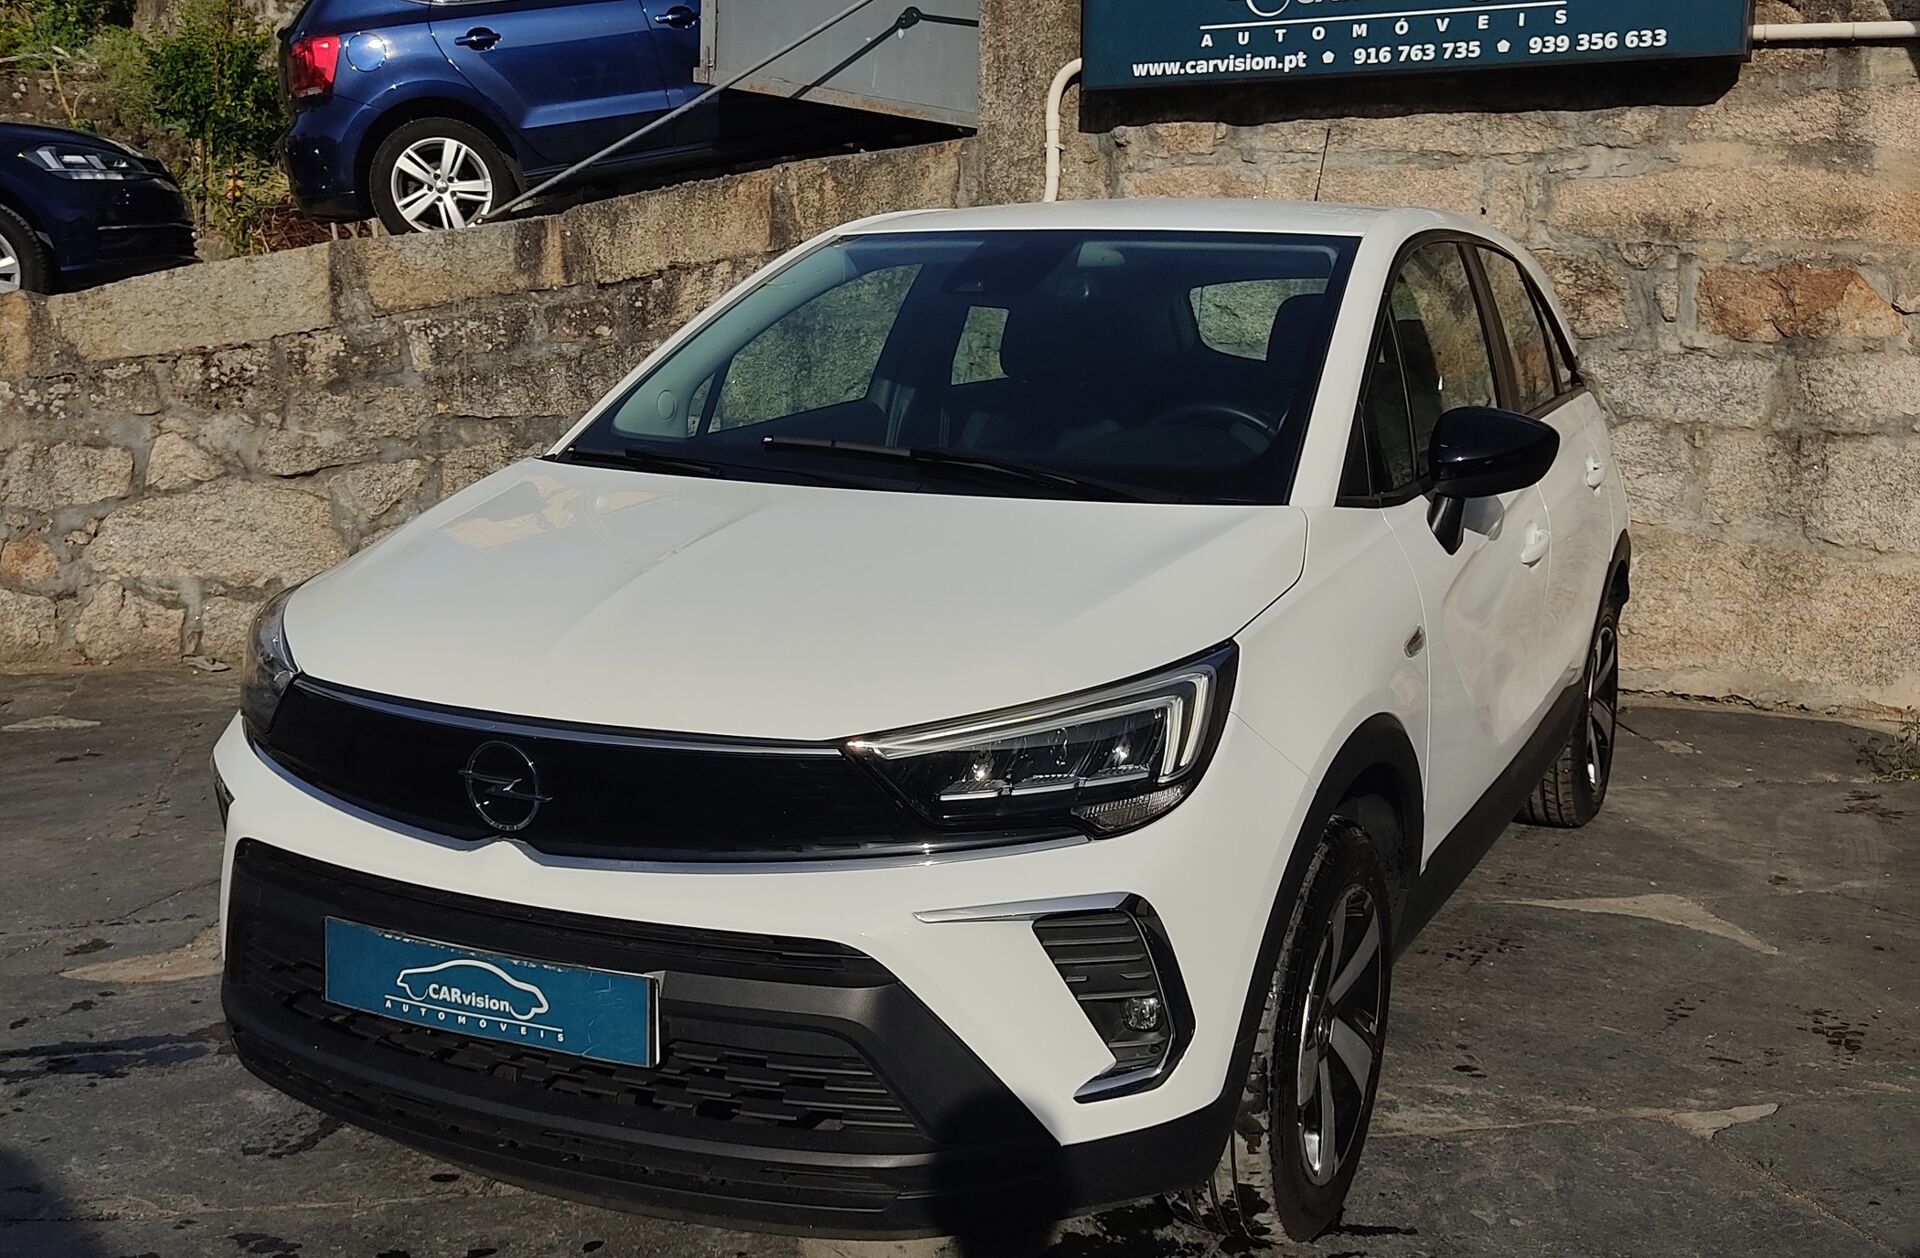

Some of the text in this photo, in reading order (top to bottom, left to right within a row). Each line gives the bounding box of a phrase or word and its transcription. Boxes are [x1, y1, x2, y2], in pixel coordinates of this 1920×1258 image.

[1200, 10, 1568, 48] AUTOMÓVEIS
[1132, 29, 1668, 77] www.carvision.pt 916 763 735 939 356 633
[428, 983, 511, 1012] CARvision
[385, 1000, 564, 1042] AUTOMÓVEIS
